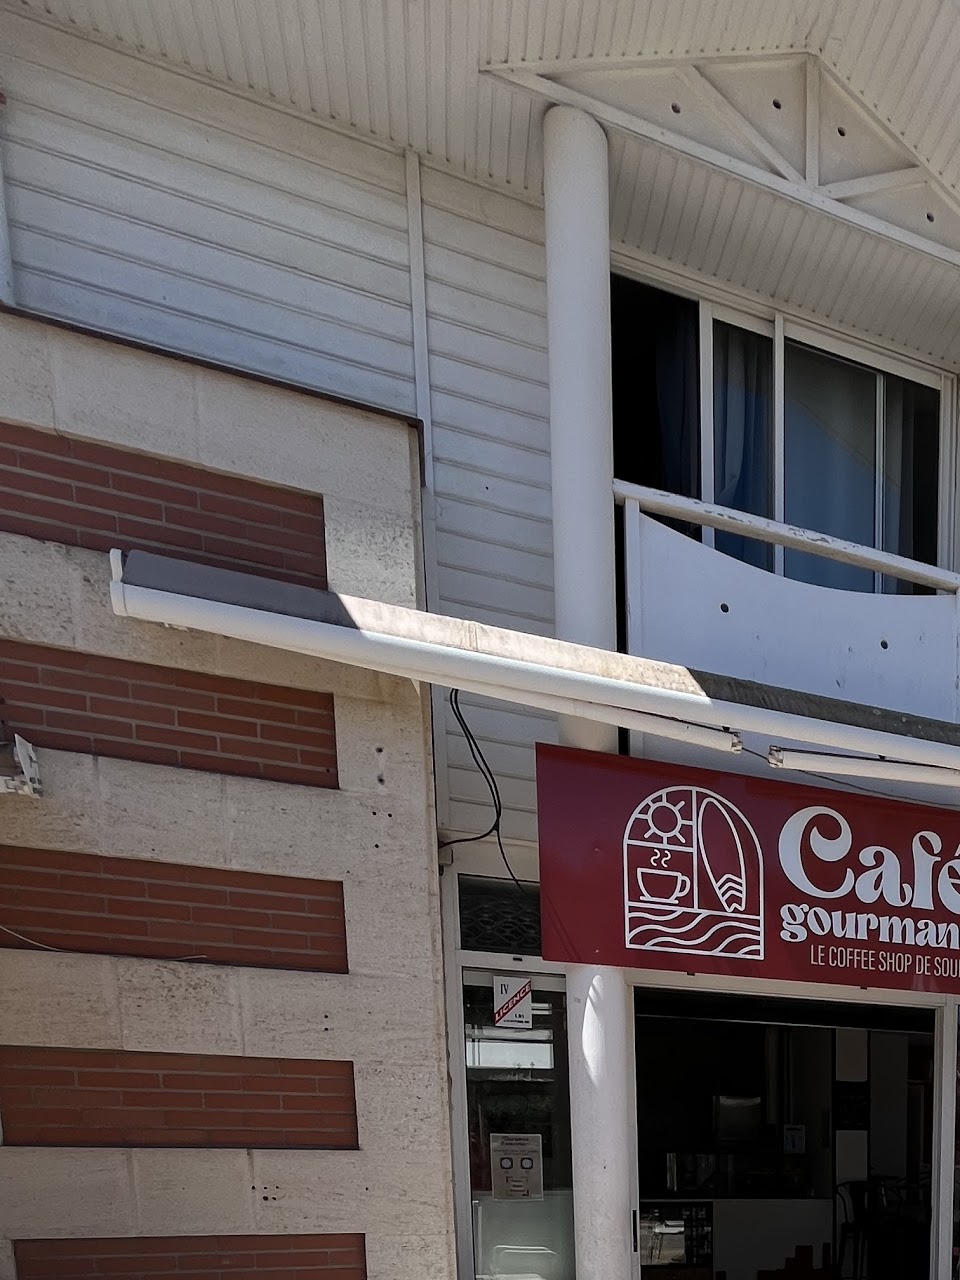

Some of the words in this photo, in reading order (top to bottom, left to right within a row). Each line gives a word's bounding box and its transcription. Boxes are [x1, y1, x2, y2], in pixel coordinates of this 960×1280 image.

[810, 943, 826, 965] LE
[829, 945, 876, 969] COFFEE
[878, 951, 913, 974] SHOP
[915, 956, 931, 976] DE
[495, 983, 531, 1021] LICENCE
[500, 983, 509, 995] IV
